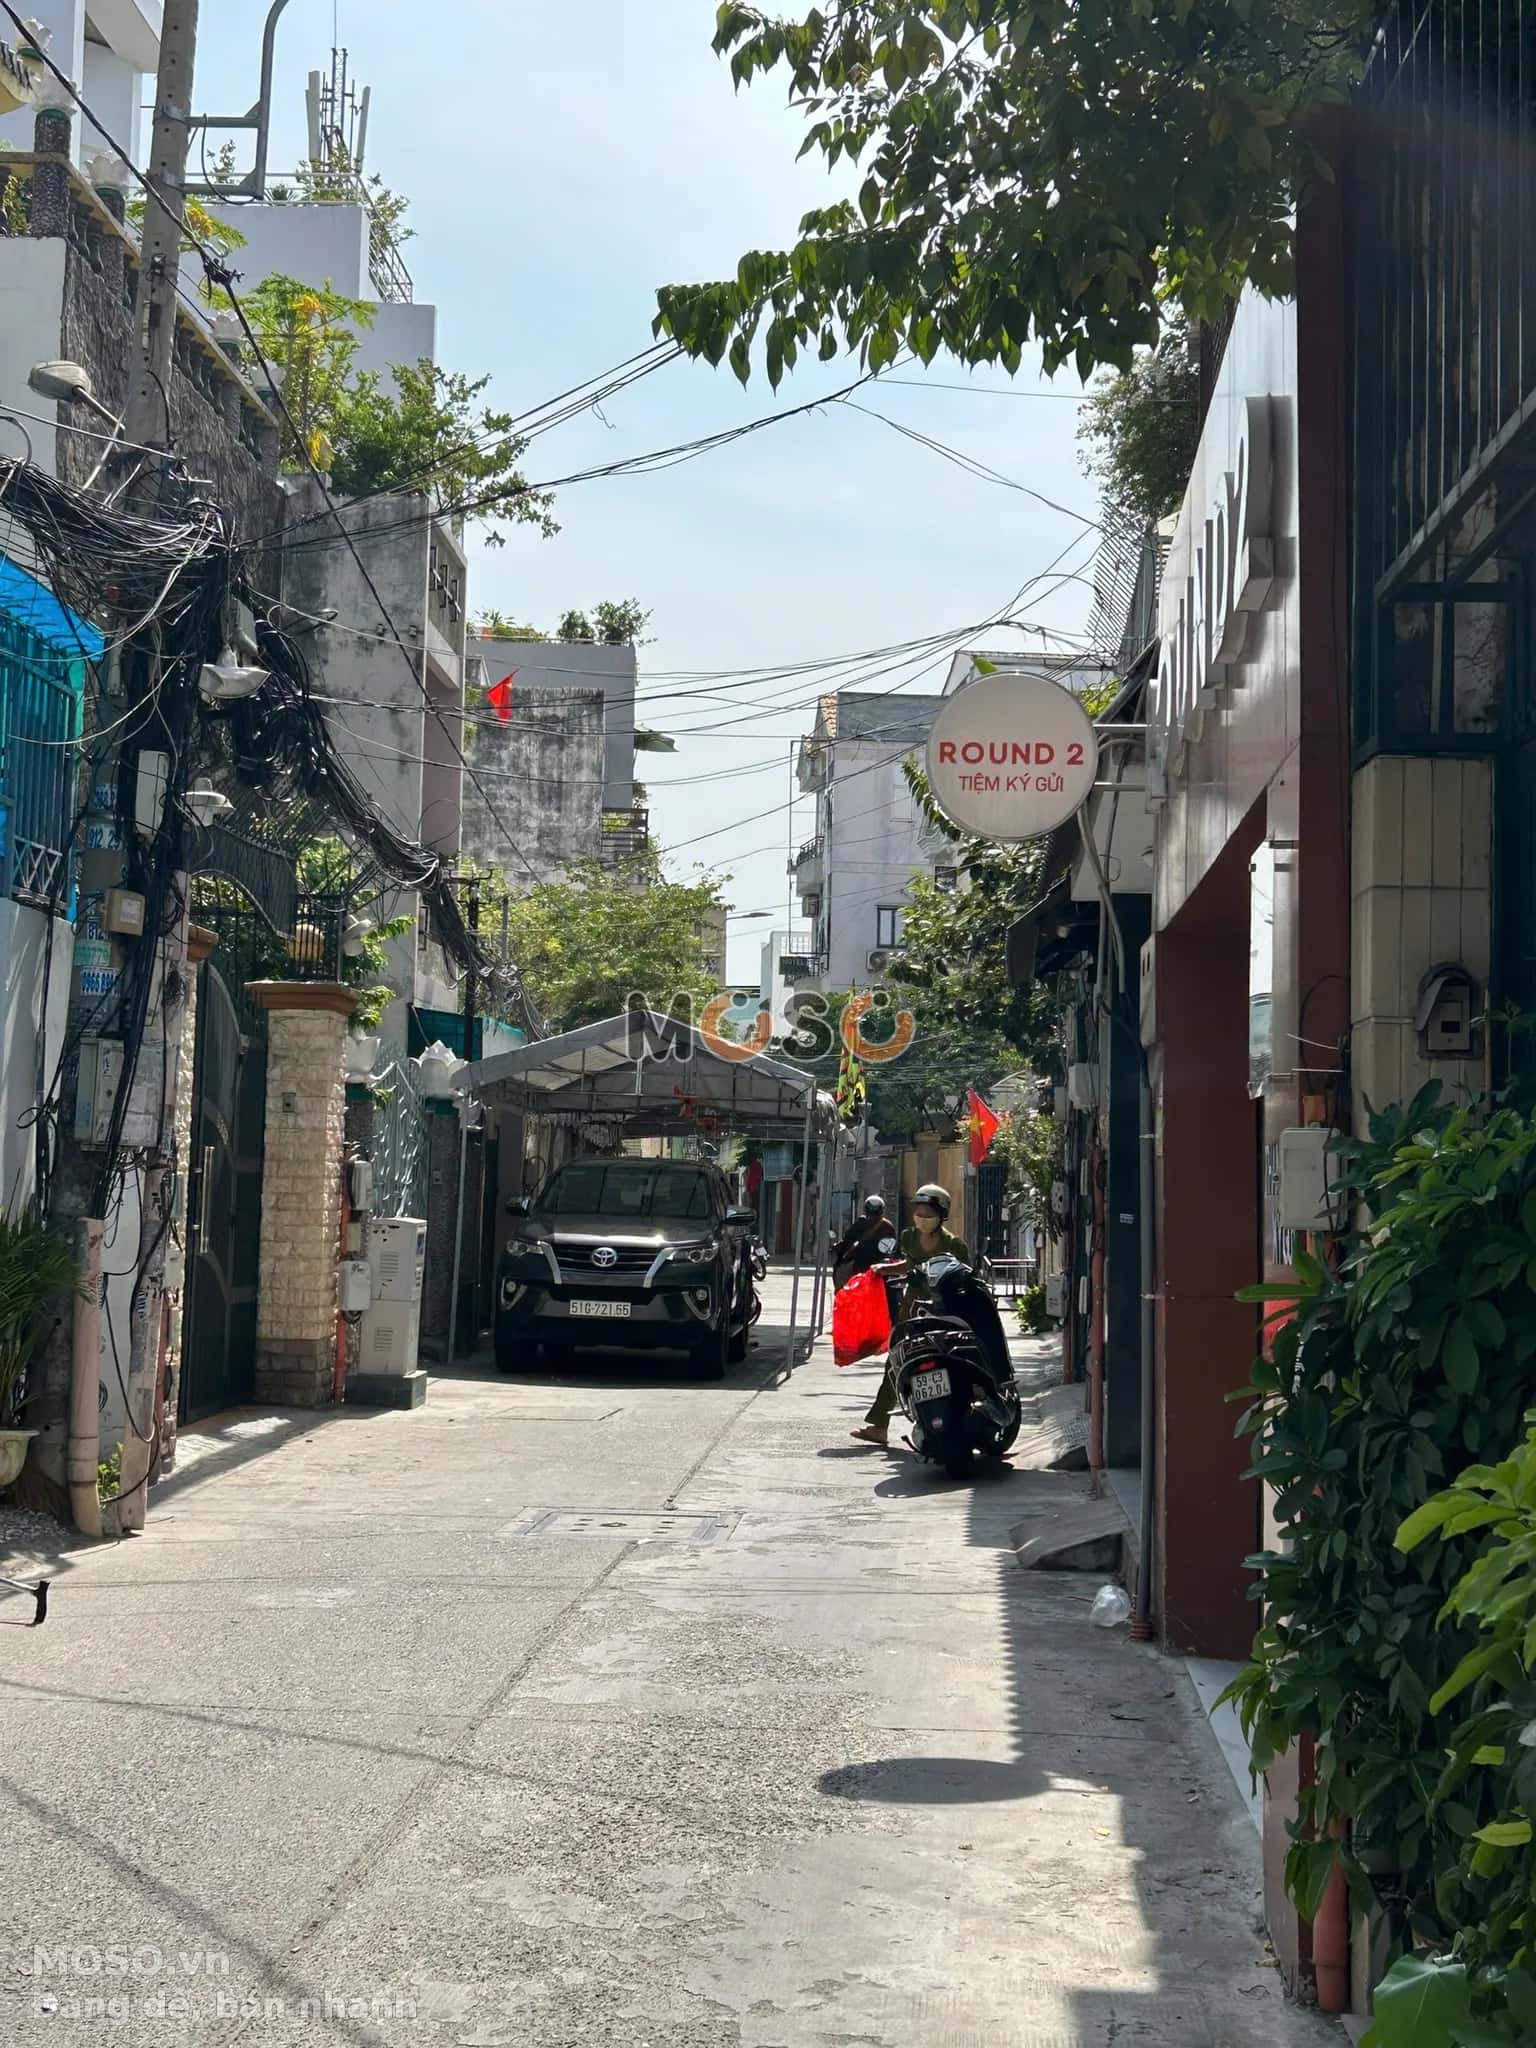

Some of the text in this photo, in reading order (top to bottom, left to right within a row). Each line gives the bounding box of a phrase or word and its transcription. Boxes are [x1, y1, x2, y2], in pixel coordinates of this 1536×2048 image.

[939, 742, 1084, 765] ROUND 2
[959, 773, 1064, 795] TIỆM KÝ GỬI
